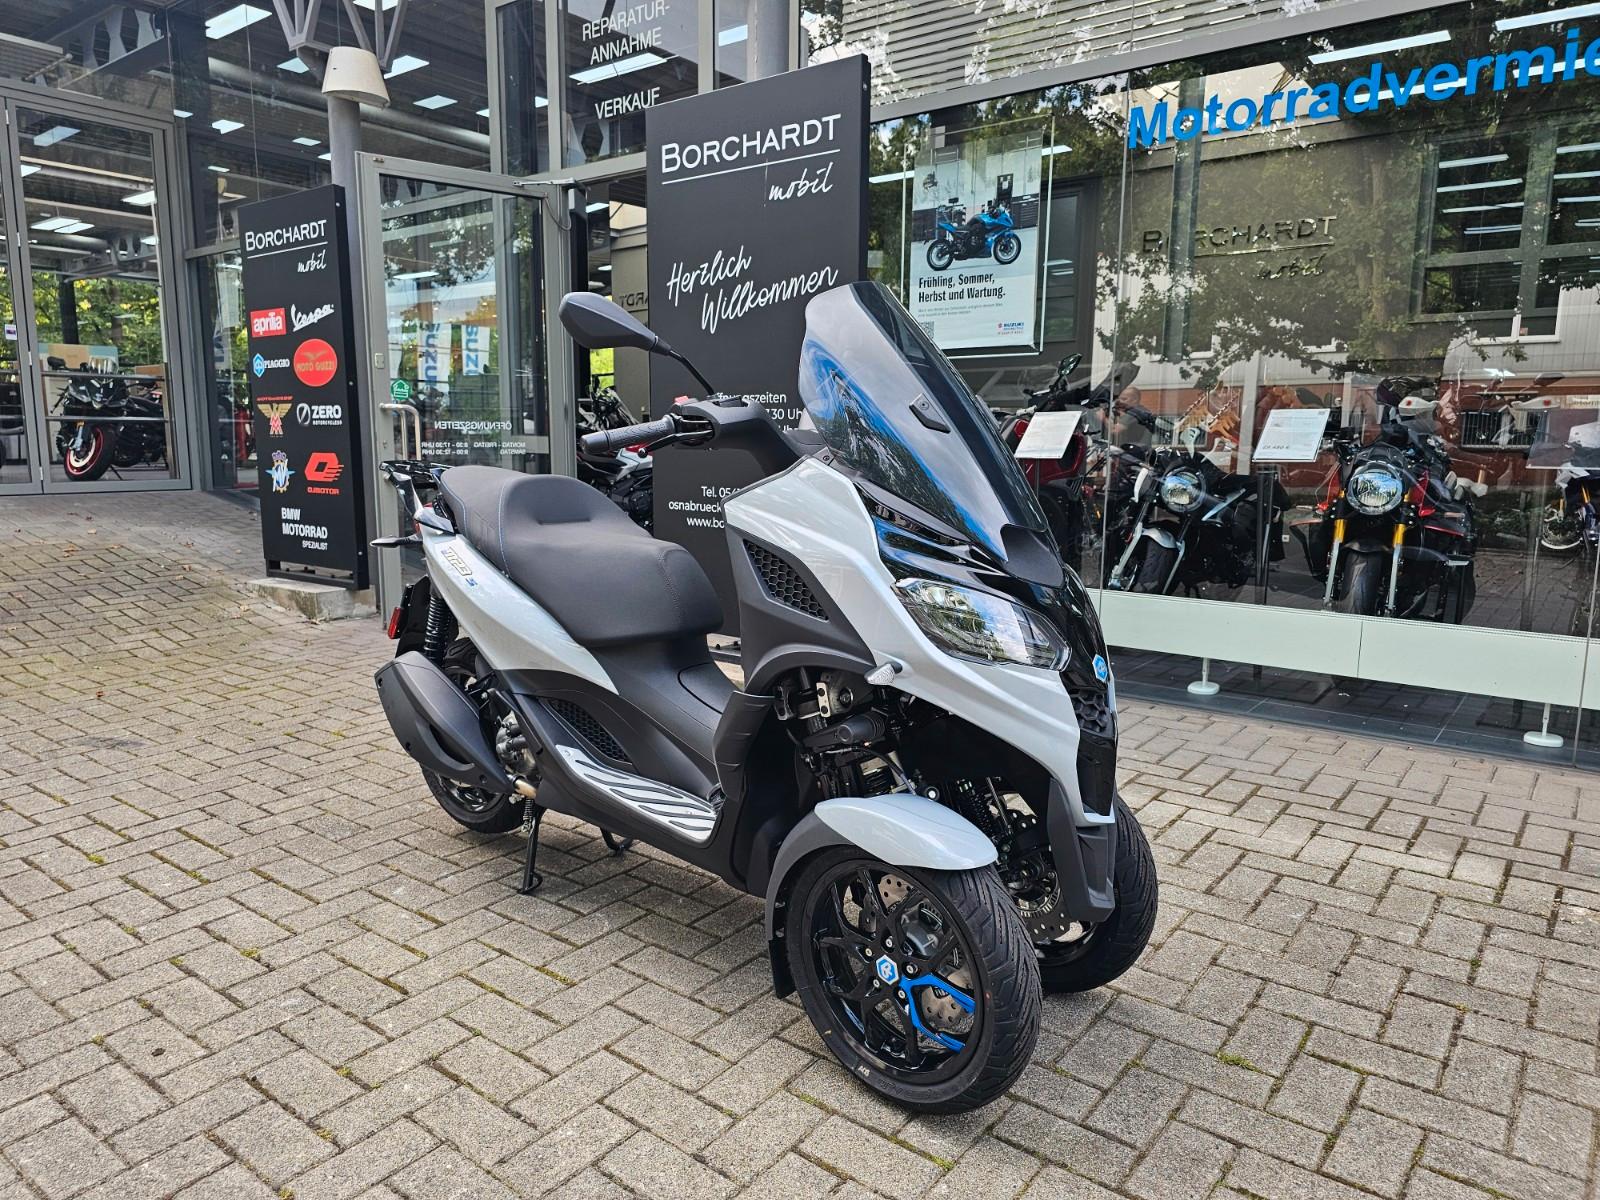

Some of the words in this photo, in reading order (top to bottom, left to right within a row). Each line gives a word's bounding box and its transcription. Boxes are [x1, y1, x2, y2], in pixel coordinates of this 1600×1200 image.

[582, 0, 670, 41] REPARATUR-
[590, 26, 662, 65] ANNAHME
[594, 86, 660, 120] VERKAUF
[661, 113, 841, 174] BORCHARDT
[768, 161, 833, 201] mobil
[245, 219, 327, 252] BORCHARDT
[297, 249, 326, 273] mobil
[666, 244, 752, 307] Herzlich
[918, 276, 956, 289] Frühling,
[958, 272, 995, 285] Sommer,
[701, 266, 839, 334] Willkommen
[918, 289, 946, 303] Herbst
[948, 288, 965, 300] und
[967, 286, 1006, 299] Wartung.
[253, 312, 284, 336] aprilia
[290, 303, 335, 332] Vespa
[264, 358, 291, 369] PIAGGIO
[311, 404, 343, 419] ZERO
[701, 485, 717, 498] Tel.
[281, 507, 301, 521] BMW
[282, 522, 329, 539] MOTORRAD
[302, 540, 328, 551] SPEZIALIST
